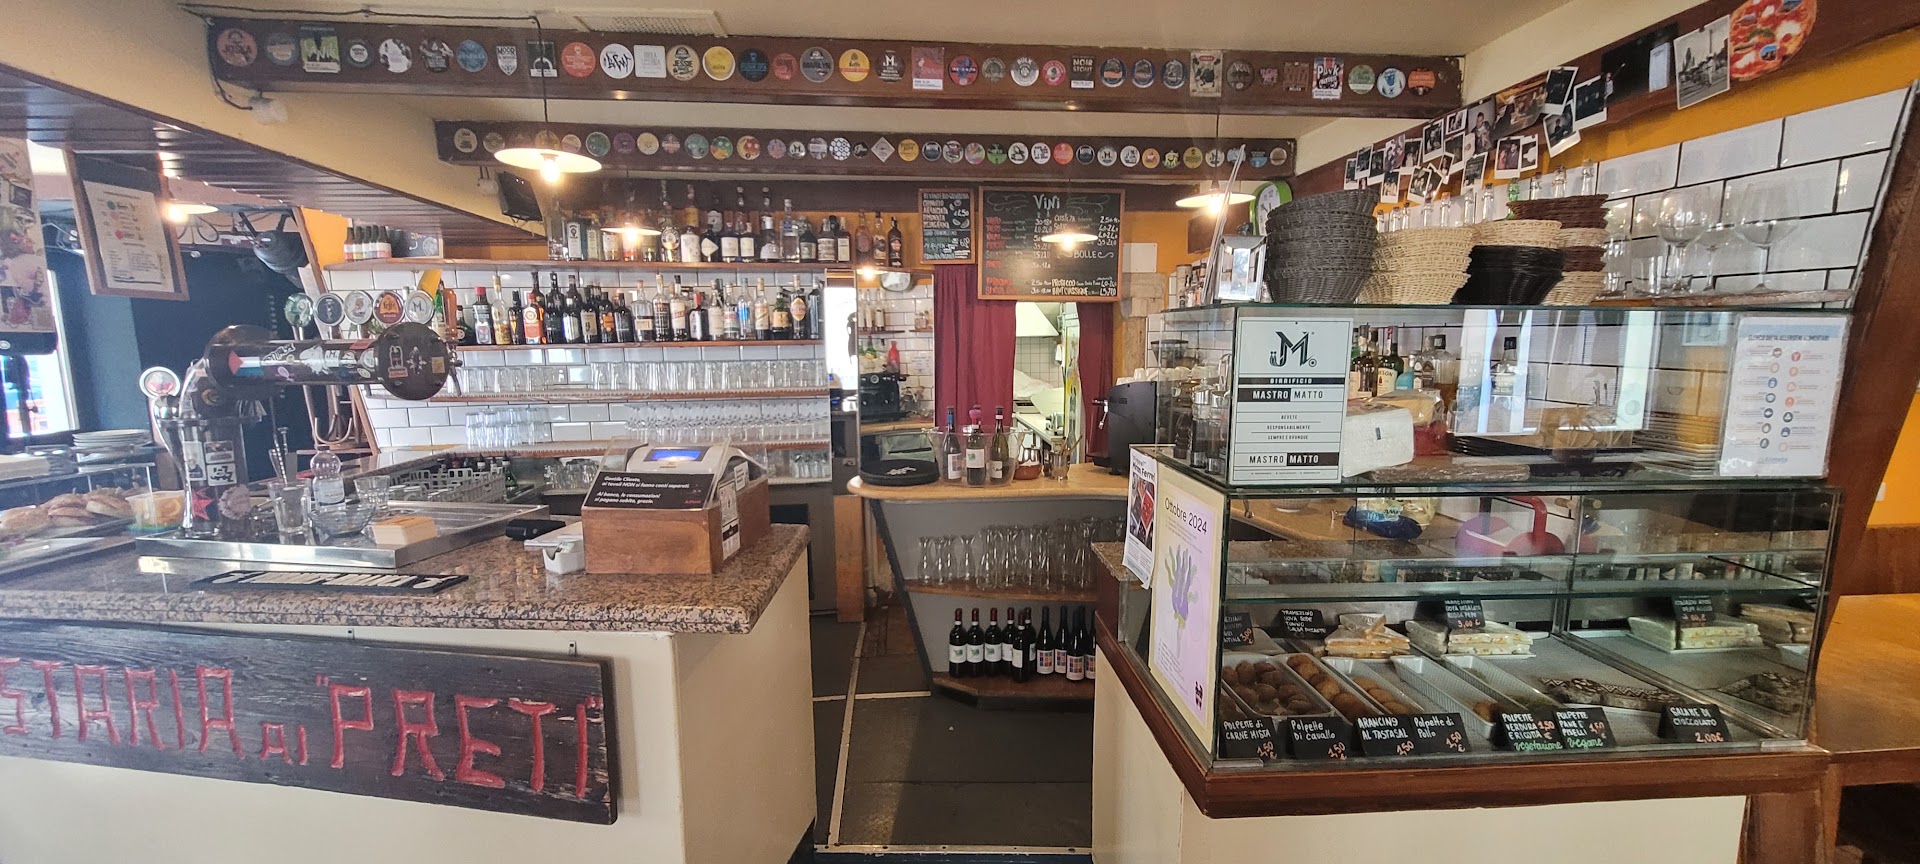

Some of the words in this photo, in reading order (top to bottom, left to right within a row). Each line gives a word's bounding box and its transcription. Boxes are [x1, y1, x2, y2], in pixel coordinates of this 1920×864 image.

[1072, 58, 1094, 66] NOIR
[1074, 250, 1096, 258] BOLLE
[1252, 390, 1288, 399] MASTRO
[1294, 390, 1324, 399] MATTO
[1249, 456, 1284, 464] MASTRO
[1289, 455, 1319, 464] MATTO
[1164, 498, 1187, 520] Ottobre
[1188, 512, 1208, 535] 2024
[1556, 711, 1588, 719] POLPETTE
[1670, 706, 1700, 717] SALAME
[1700, 708, 1711, 717] DI
[1414, 716, 1444, 728] Polpette
[1446, 716, 1454, 726] di
[1502, 713, 1534, 722] POLPETTE
[1673, 718, 1717, 726] CIOCCOLATO
[1224, 720, 1254, 730] POLPETTE
[1256, 720, 1264, 728] di
[1291, 720, 1324, 732] Polpette
[1506, 723, 1538, 731] VERDURA
[1538, 720, 1555, 731] 1,50
[1559, 720, 1578, 728] PANE
[1226, 730, 1248, 740] CARNE
[1250, 729, 1271, 740] MISTA
[1306, 730, 1336, 740] cavallo
[1362, 730, 1372, 740] AL
[1372, 728, 1408, 740] TASTASAL
[1417, 728, 1436, 738] Pollo
[1515, 730, 1542, 740] RICOTTA
[1562, 728, 1587, 736] PISELLI
[1446, 731, 1462, 748] 1,50
[1328, 742, 1345, 758] 1,50
